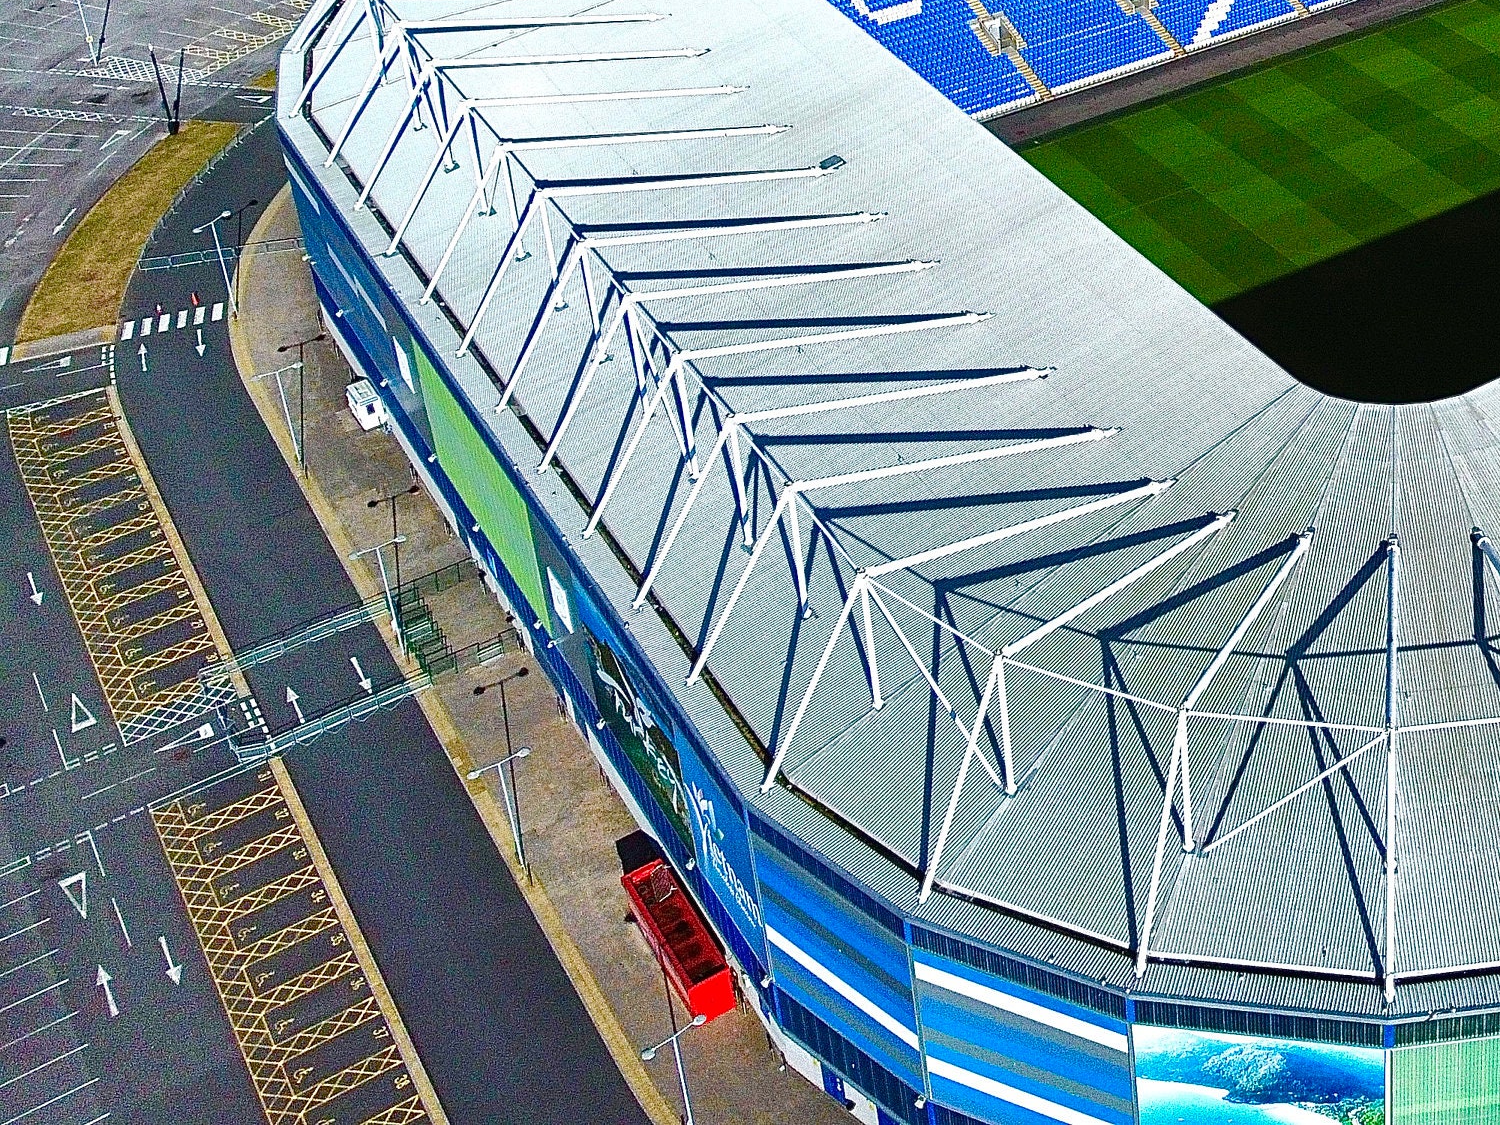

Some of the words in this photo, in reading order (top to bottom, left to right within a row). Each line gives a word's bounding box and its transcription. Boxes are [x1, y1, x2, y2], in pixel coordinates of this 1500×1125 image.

[257, 771, 272, 782] 31
[274, 808, 289, 820] 32
[292, 848, 307, 861] 33
[311, 889, 325, 903] 34
[331, 932, 346, 945] 35
[350, 976, 365, 990] 36
[373, 1026, 388, 1040] 37
[394, 1074, 411, 1088] 38
